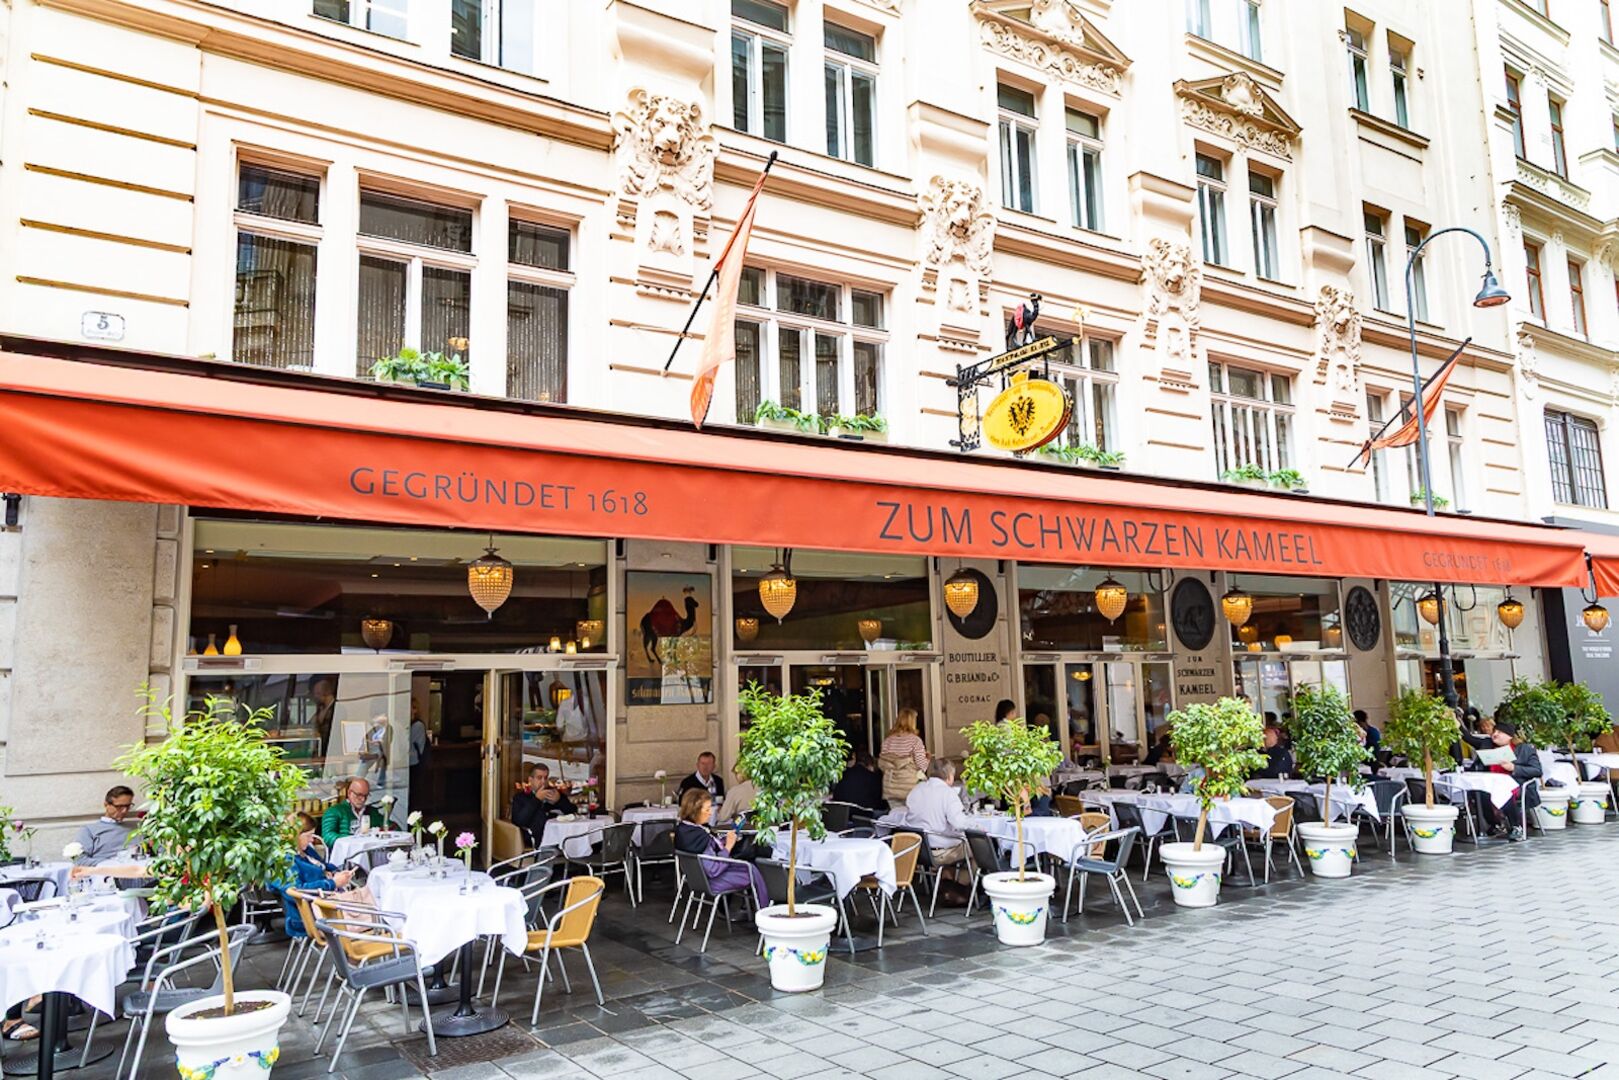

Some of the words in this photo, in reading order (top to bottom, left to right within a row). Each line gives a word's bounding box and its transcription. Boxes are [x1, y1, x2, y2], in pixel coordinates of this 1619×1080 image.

[97, 315, 109, 329] 5
[350, 467, 576, 510] GEGRÜNDET
[588, 489, 649, 516] 1618
[876, 501, 973, 545] ZUM
[990, 510, 1205, 558] SCHWARZEN
[1215, 527, 1323, 565] KAMEEL
[949, 653, 997, 662] BOUTILLIER
[1179, 684, 1216, 695] KAMEEL
[958, 695, 991, 703] COGNAC
